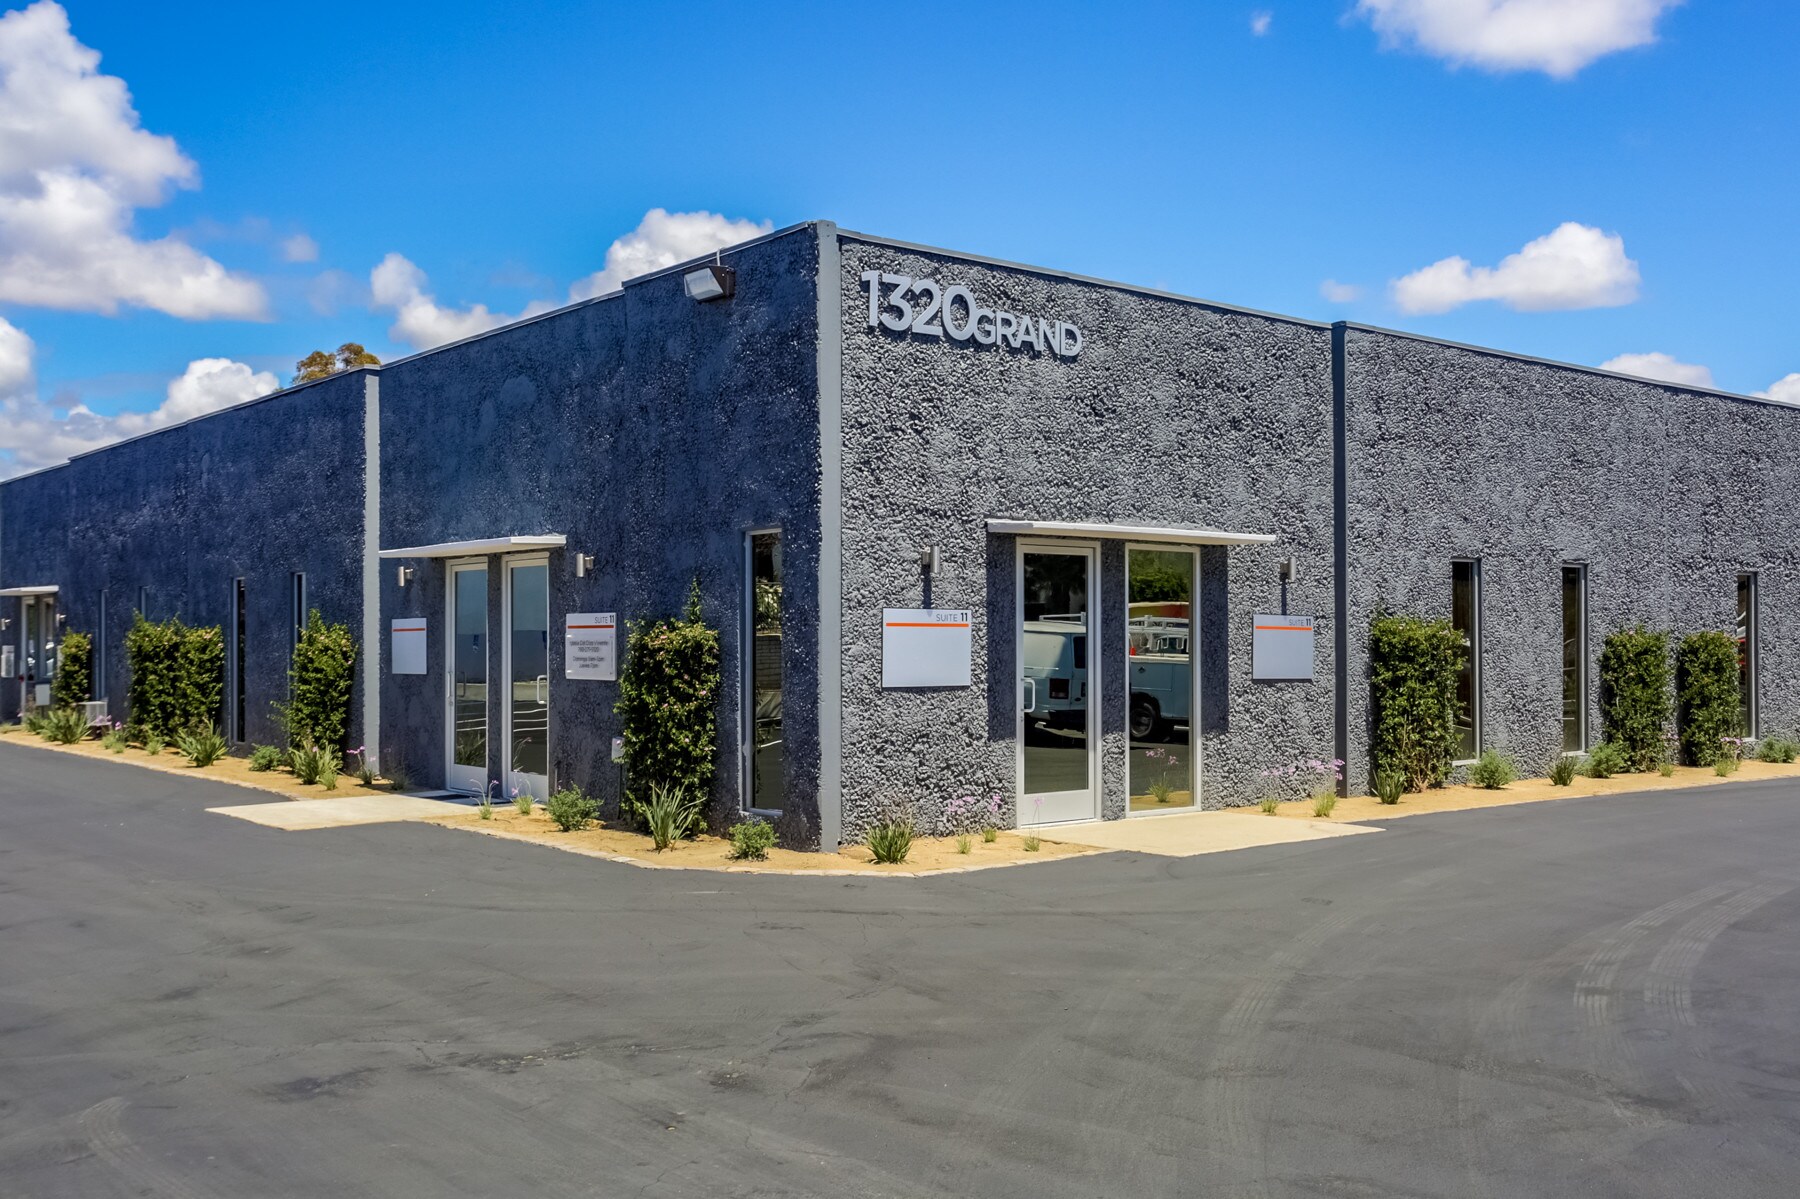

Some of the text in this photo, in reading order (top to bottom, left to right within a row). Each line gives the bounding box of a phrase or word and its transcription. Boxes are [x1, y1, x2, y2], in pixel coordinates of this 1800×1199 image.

[861, 270, 1083, 357] 1320 GRAND
[594, 615, 615, 624] SUITE 11
[935, 612, 968, 622] SUITE 11
[1288, 618, 1312, 626] SUITE 11
